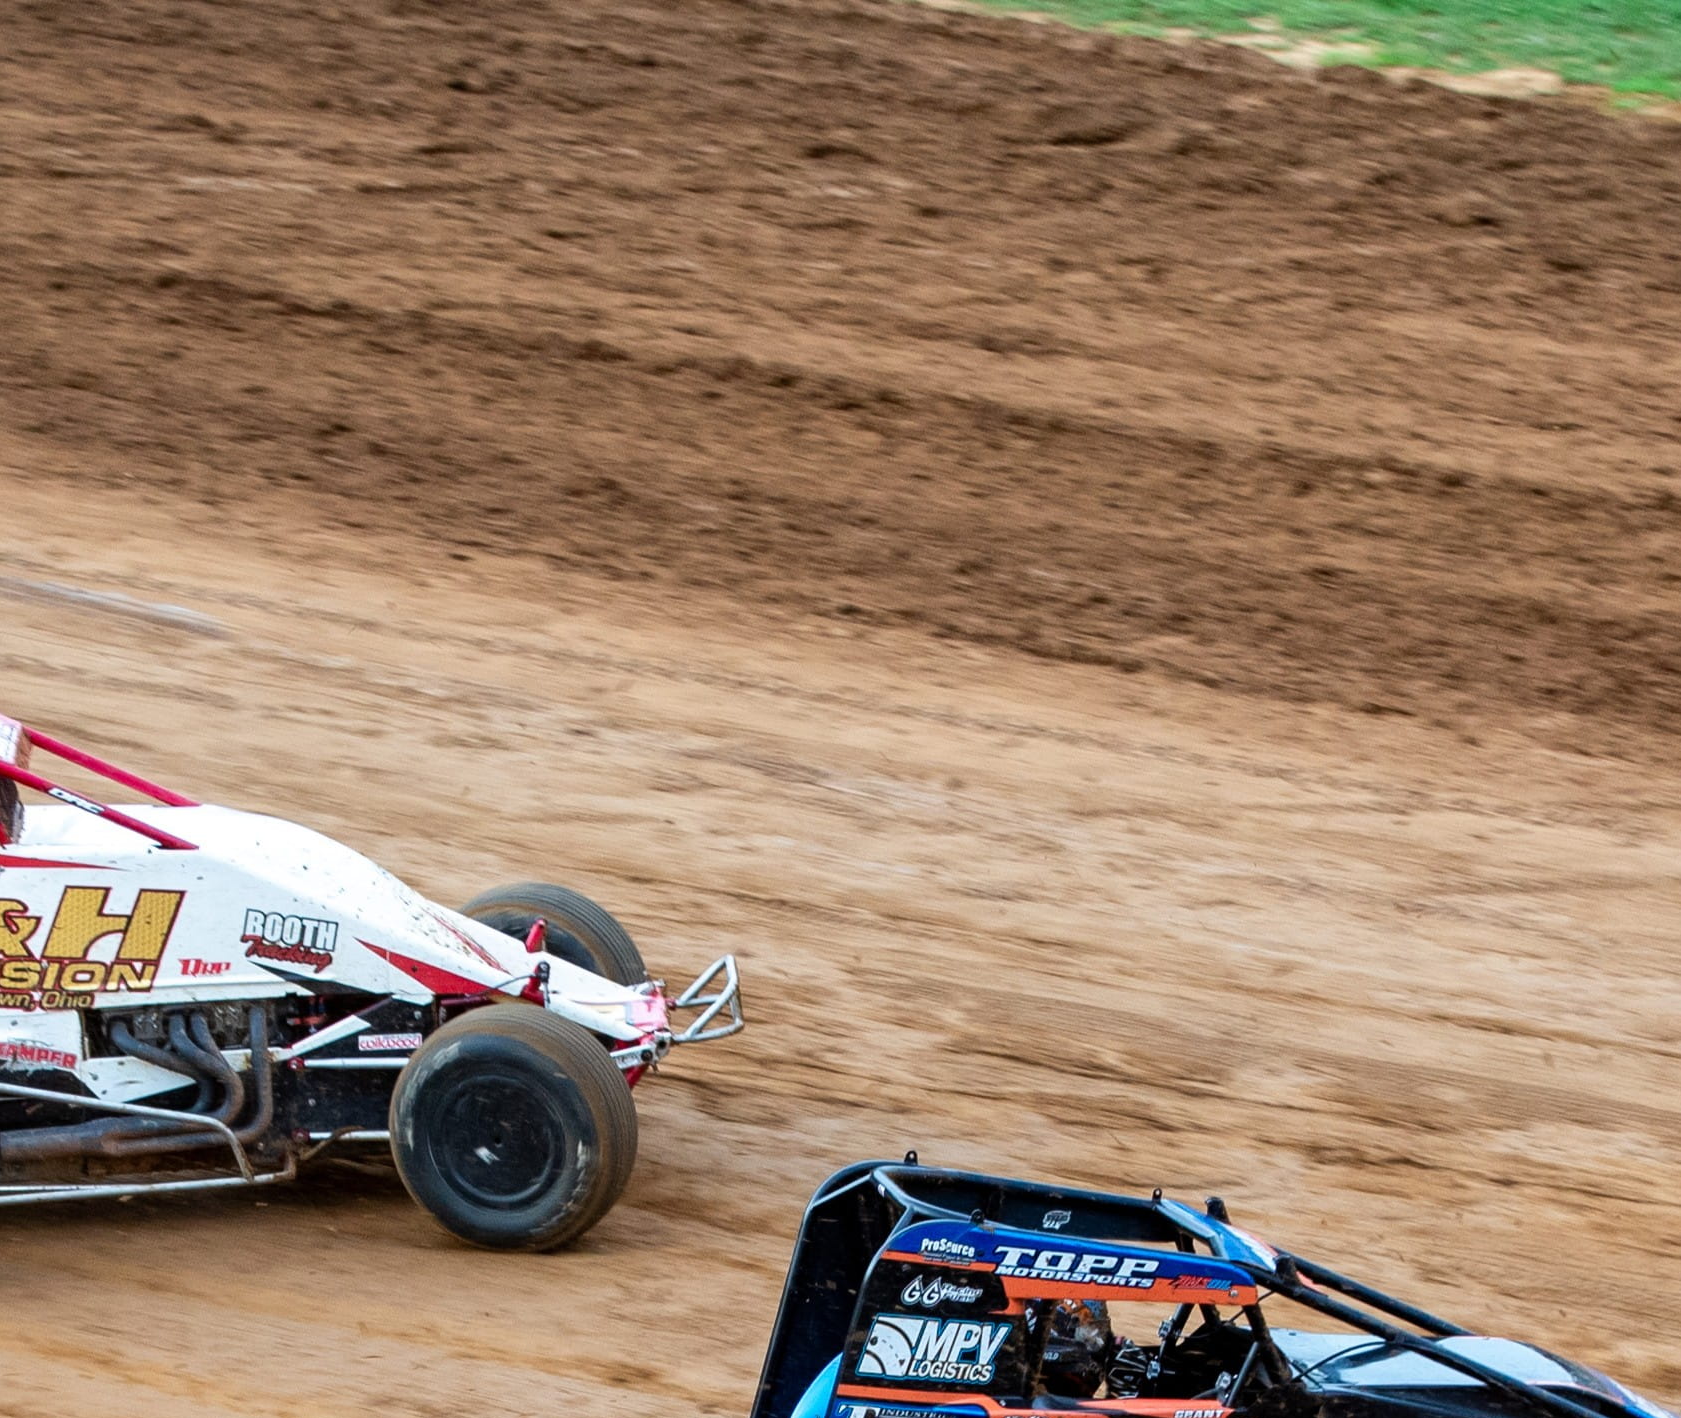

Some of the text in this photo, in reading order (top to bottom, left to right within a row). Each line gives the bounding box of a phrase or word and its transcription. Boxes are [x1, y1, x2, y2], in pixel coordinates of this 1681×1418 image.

[243, 908, 339, 952] BOOTH
[40, 990, 94, 1010] Ohio
[921, 1238, 975, 1258] ProSource
[995, 1246, 1159, 1278] TOPP
[994, 1266, 1154, 1288] MOTORSPORTS
[914, 1320, 1010, 1365] MPV
[908, 1360, 992, 1382] LOGISTICS
